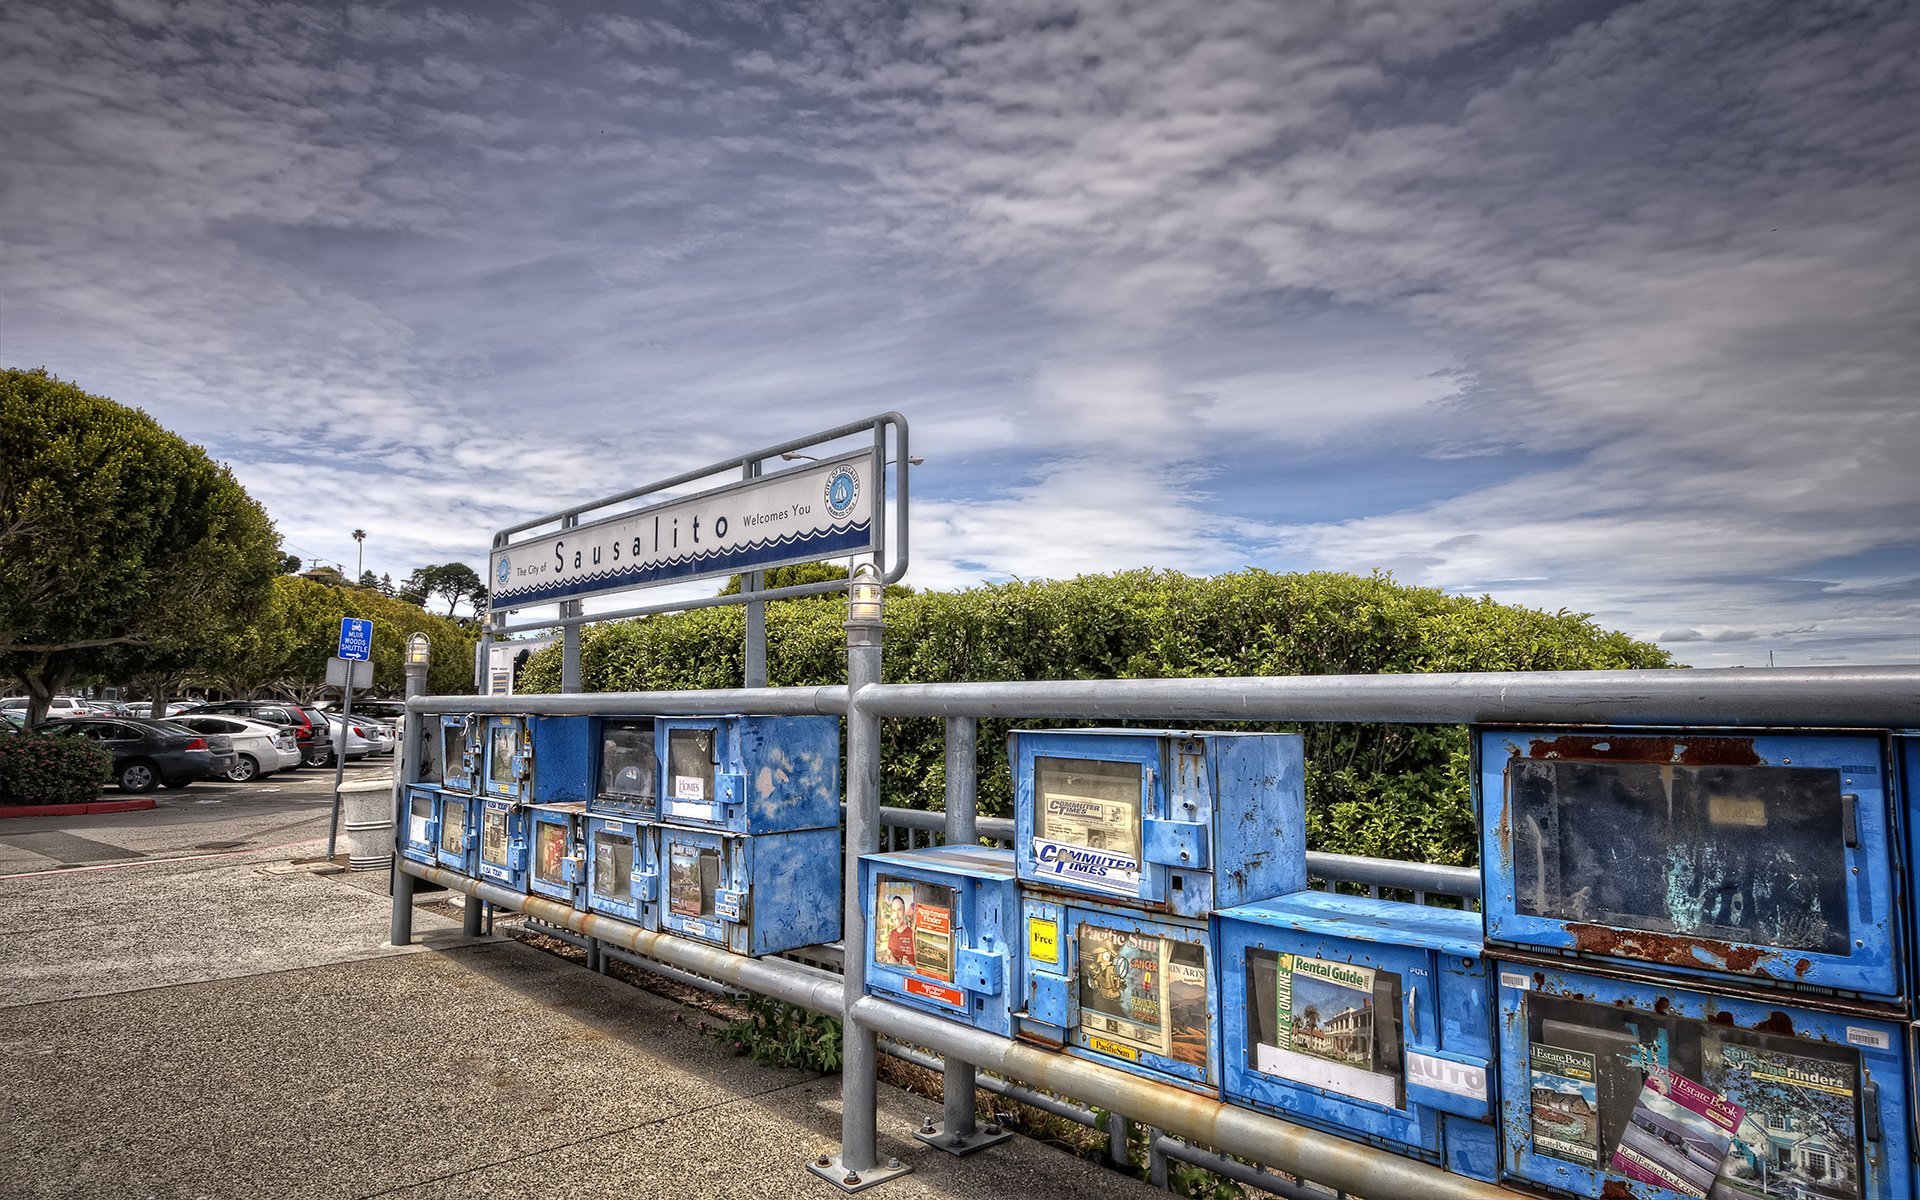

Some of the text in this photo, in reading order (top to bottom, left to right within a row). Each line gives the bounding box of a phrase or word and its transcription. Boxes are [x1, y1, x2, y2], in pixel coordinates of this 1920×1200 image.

[839, 466, 859, 490] SAUSALITO
[517, 567, 526, 576] The
[528, 564, 539, 576] City
[540, 561, 547, 572] of
[554, 515, 728, 574] Sausalito
[742, 509, 789, 528] Welcomes
[791, 502, 812, 519] You
[344, 637, 366, 646] WOODS
[348, 631, 364, 639] MUIR
[341, 643, 369, 653] SHUTTLE
[678, 779, 700, 792] HOMES
[1049, 800, 1100, 811] COMMUTER
[1059, 806, 1087, 815] TIMES
[917, 908, 949, 920] Apartment
[923, 915, 943, 925] Finder
[1034, 932, 1053, 945] Free
[1081, 924, 1158, 953] Pacific Sun
[1129, 958, 1159, 973] CANCER
[1168, 964, 1205, 979] RIN ARTS
[1295, 957, 1331, 978] Rental
[1331, 966, 1364, 987] Guide
[1278, 971, 1292, 1050] RINT & ONLINE
[1537, 1048, 1564, 1063] Estate
[1565, 1054, 1592, 1069] Book
[1408, 1055, 1485, 1091] AUTO
[1679, 1079, 1710, 1103] Estate
[1710, 1095, 1738, 1118] Book
[1620, 1146, 1701, 1198] RealEstateBook.com
